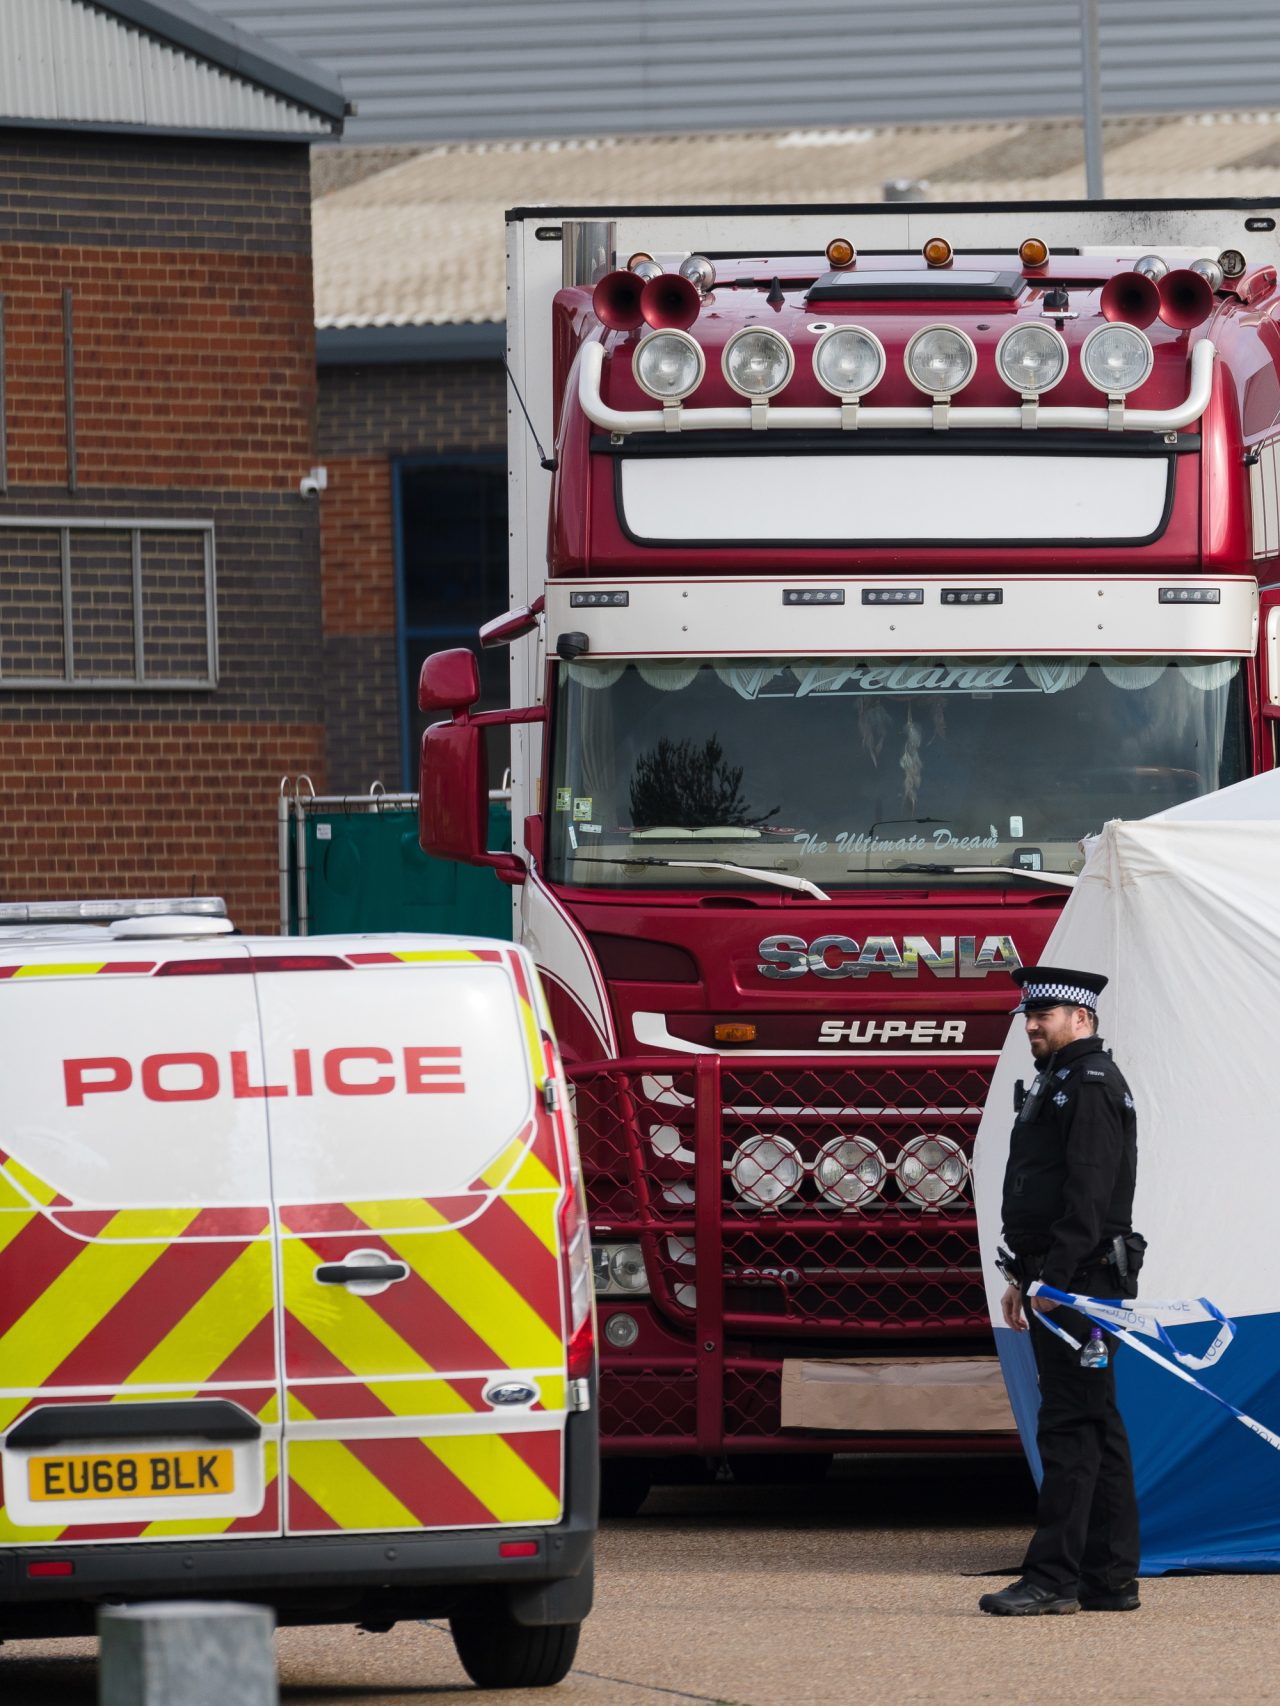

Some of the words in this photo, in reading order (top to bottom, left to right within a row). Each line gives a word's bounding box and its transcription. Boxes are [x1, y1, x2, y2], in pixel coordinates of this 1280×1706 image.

[793, 833, 829, 856] The
[834, 831, 926, 853] Ultimate
[932, 828, 999, 850] Dream
[756, 935, 1023, 980] SCANIA
[817, 1020, 967, 1043] SUPER
[62, 1045, 466, 1107] POLICE
[43, 1458, 138, 1495] EU68
[150, 1455, 220, 1491] BLK
